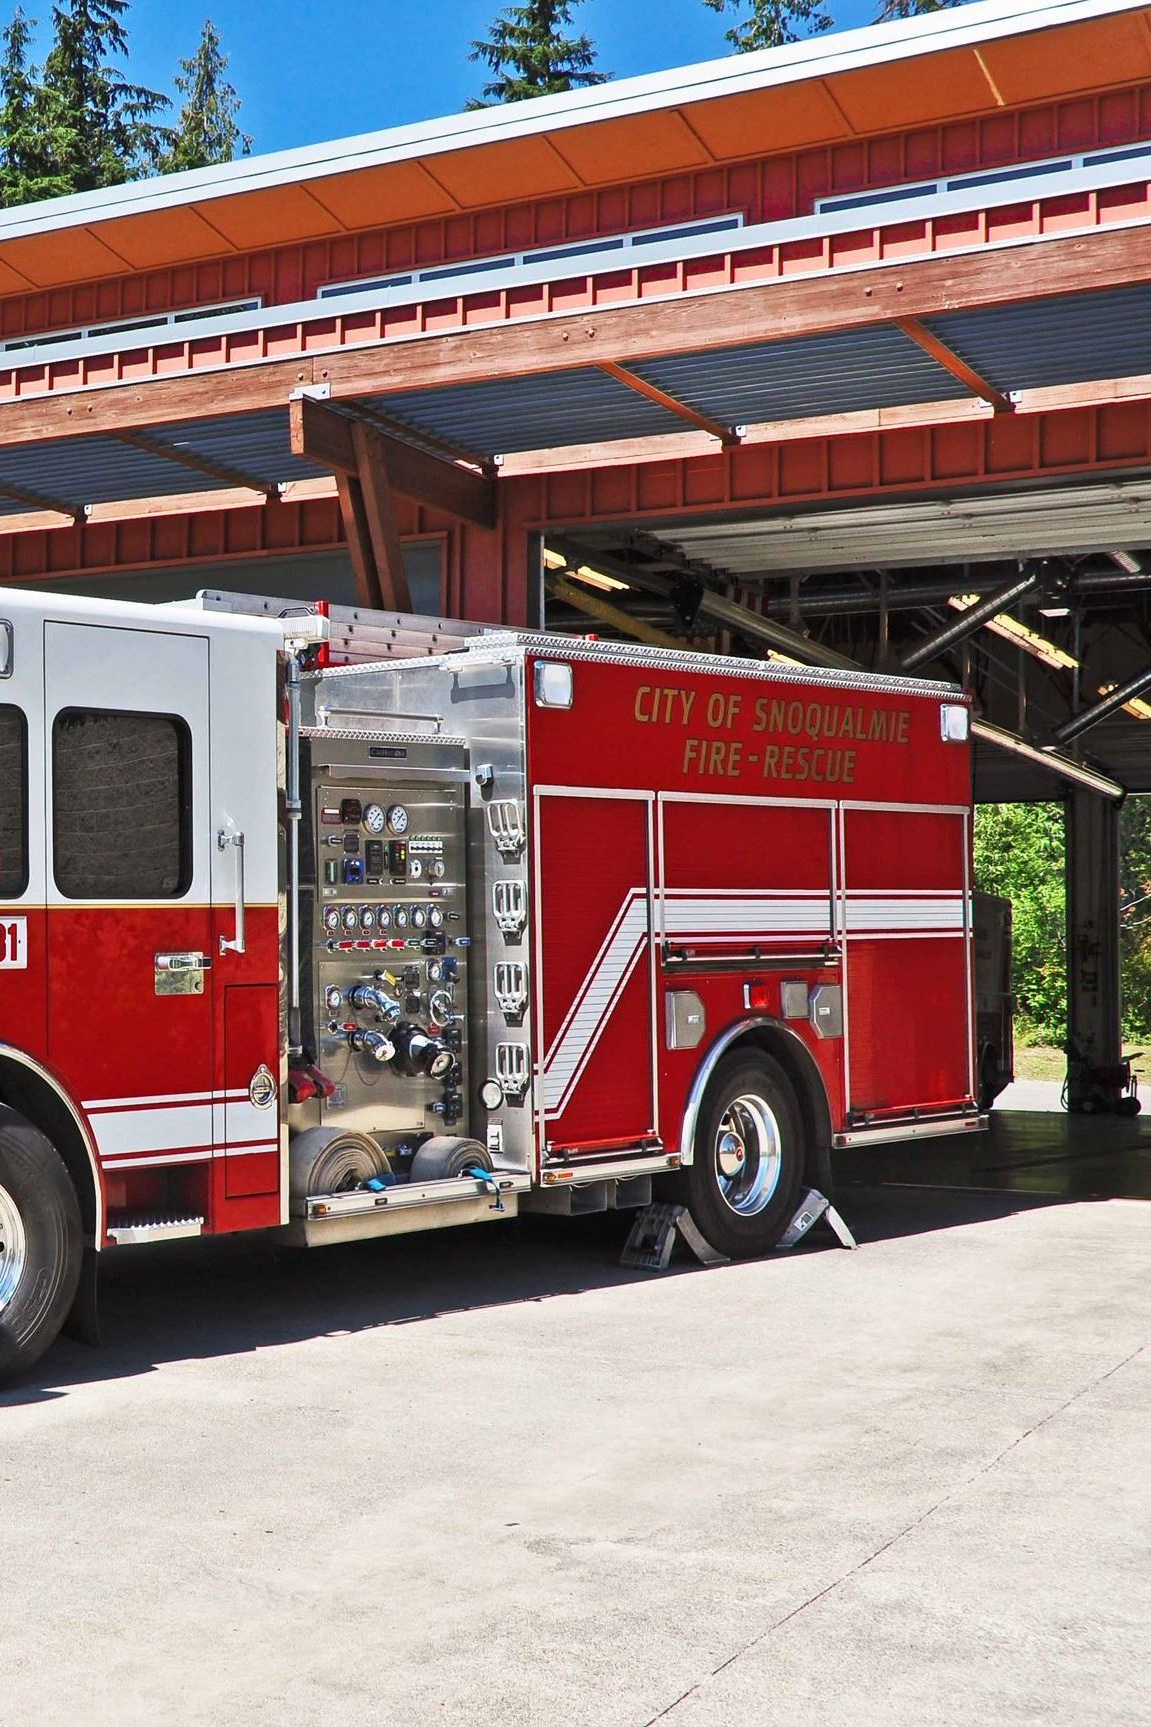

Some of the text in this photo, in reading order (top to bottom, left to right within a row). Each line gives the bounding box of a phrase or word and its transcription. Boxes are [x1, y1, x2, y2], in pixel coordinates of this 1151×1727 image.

[633, 685, 910, 744] CITY OF SNOQUALMIE
